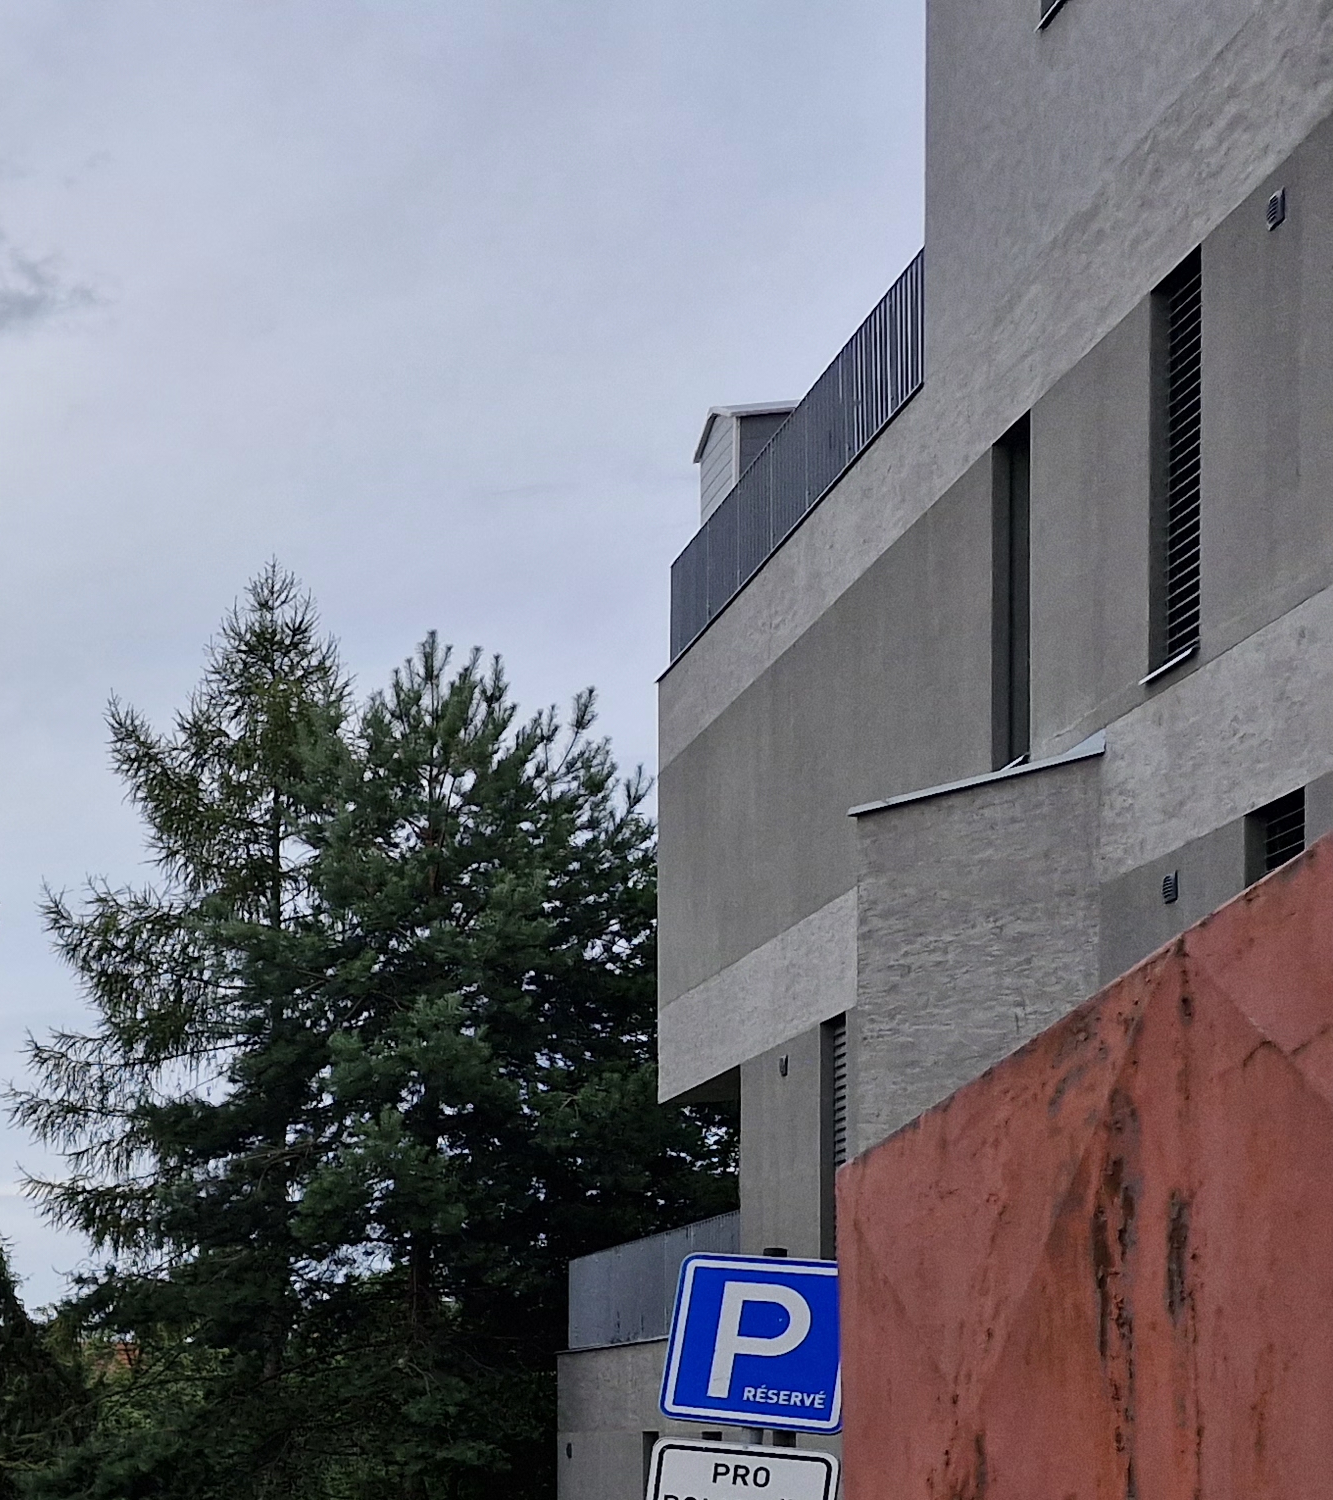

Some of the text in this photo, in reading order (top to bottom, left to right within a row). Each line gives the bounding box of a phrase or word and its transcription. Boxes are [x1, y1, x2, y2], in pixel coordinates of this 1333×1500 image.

[706, 1280, 812, 1399] P
[742, 1384, 826, 1410] RÉSERVÉ
[712, 1462, 771, 1488] PRO
